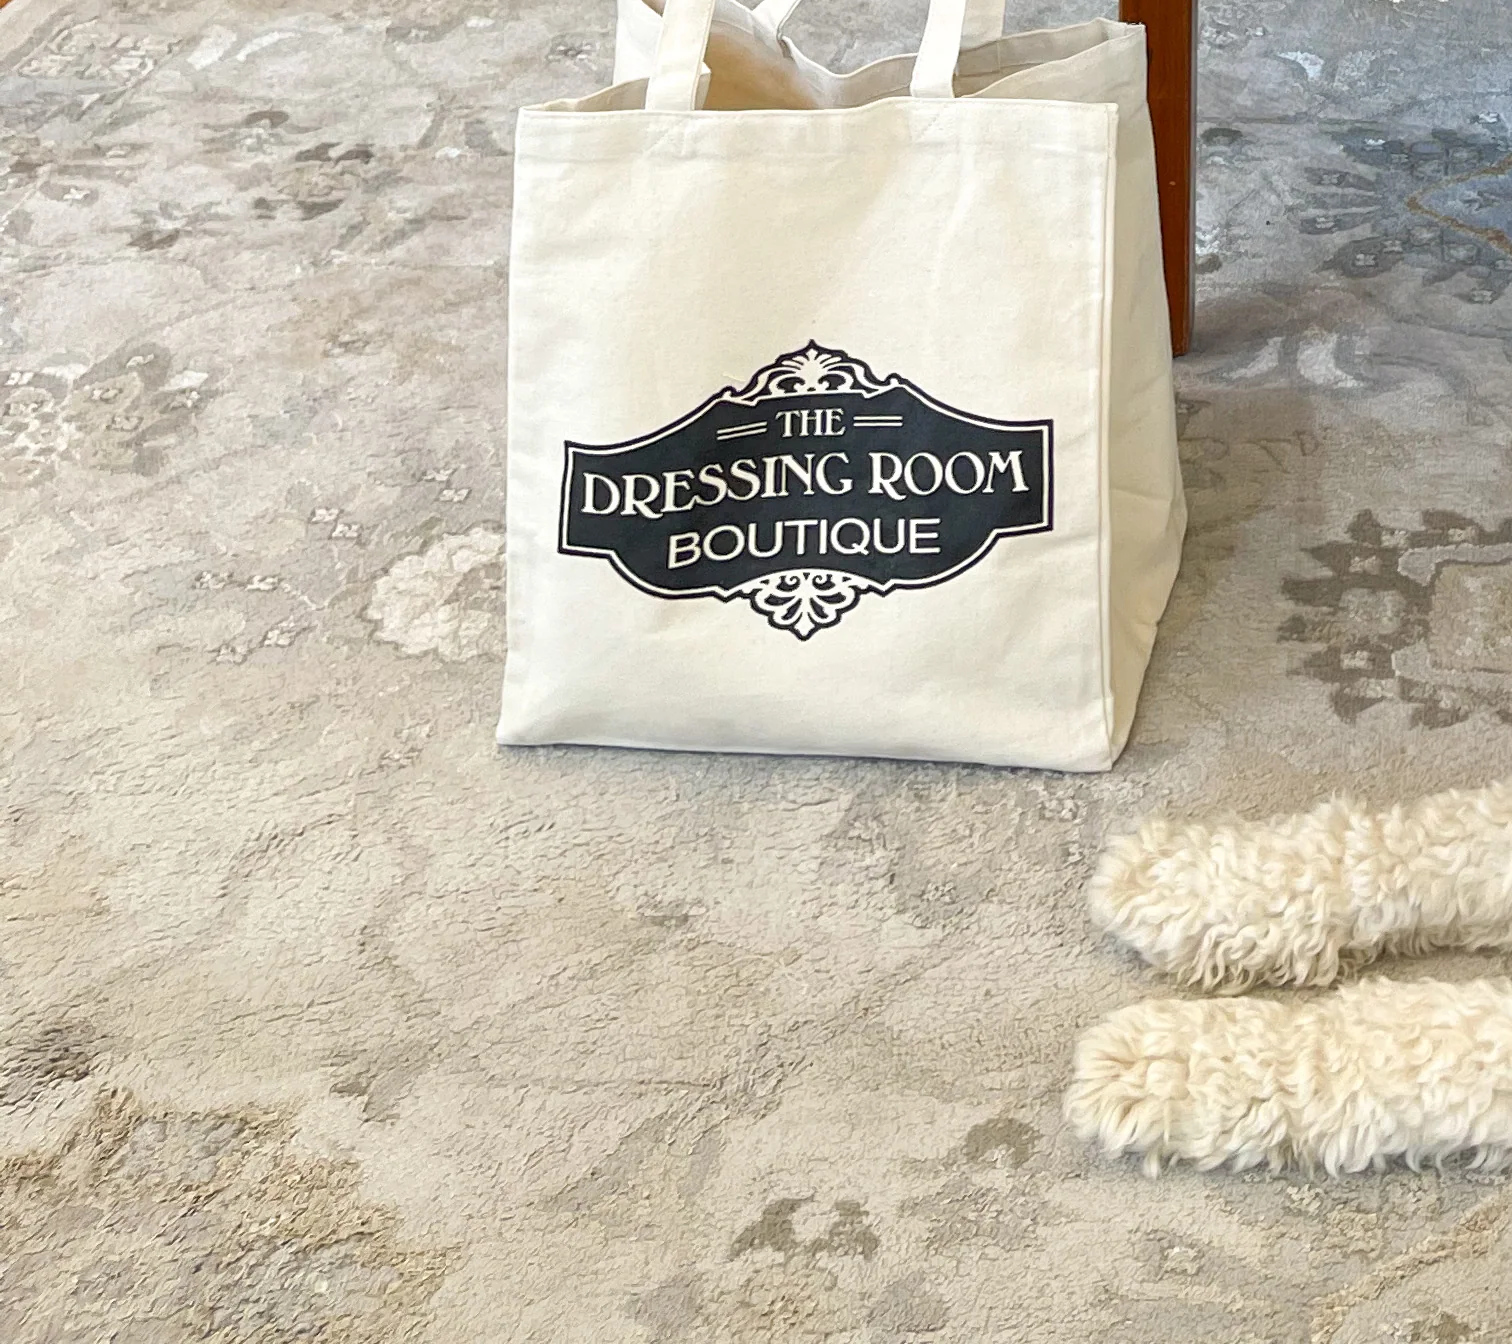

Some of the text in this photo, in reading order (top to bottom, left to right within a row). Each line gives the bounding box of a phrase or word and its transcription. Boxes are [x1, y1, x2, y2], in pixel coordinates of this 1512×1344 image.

[775, 407, 846, 438] THE
[581, 449, 1030, 520] DRESSING ROOM
[667, 517, 942, 570] BOUTIQUE
